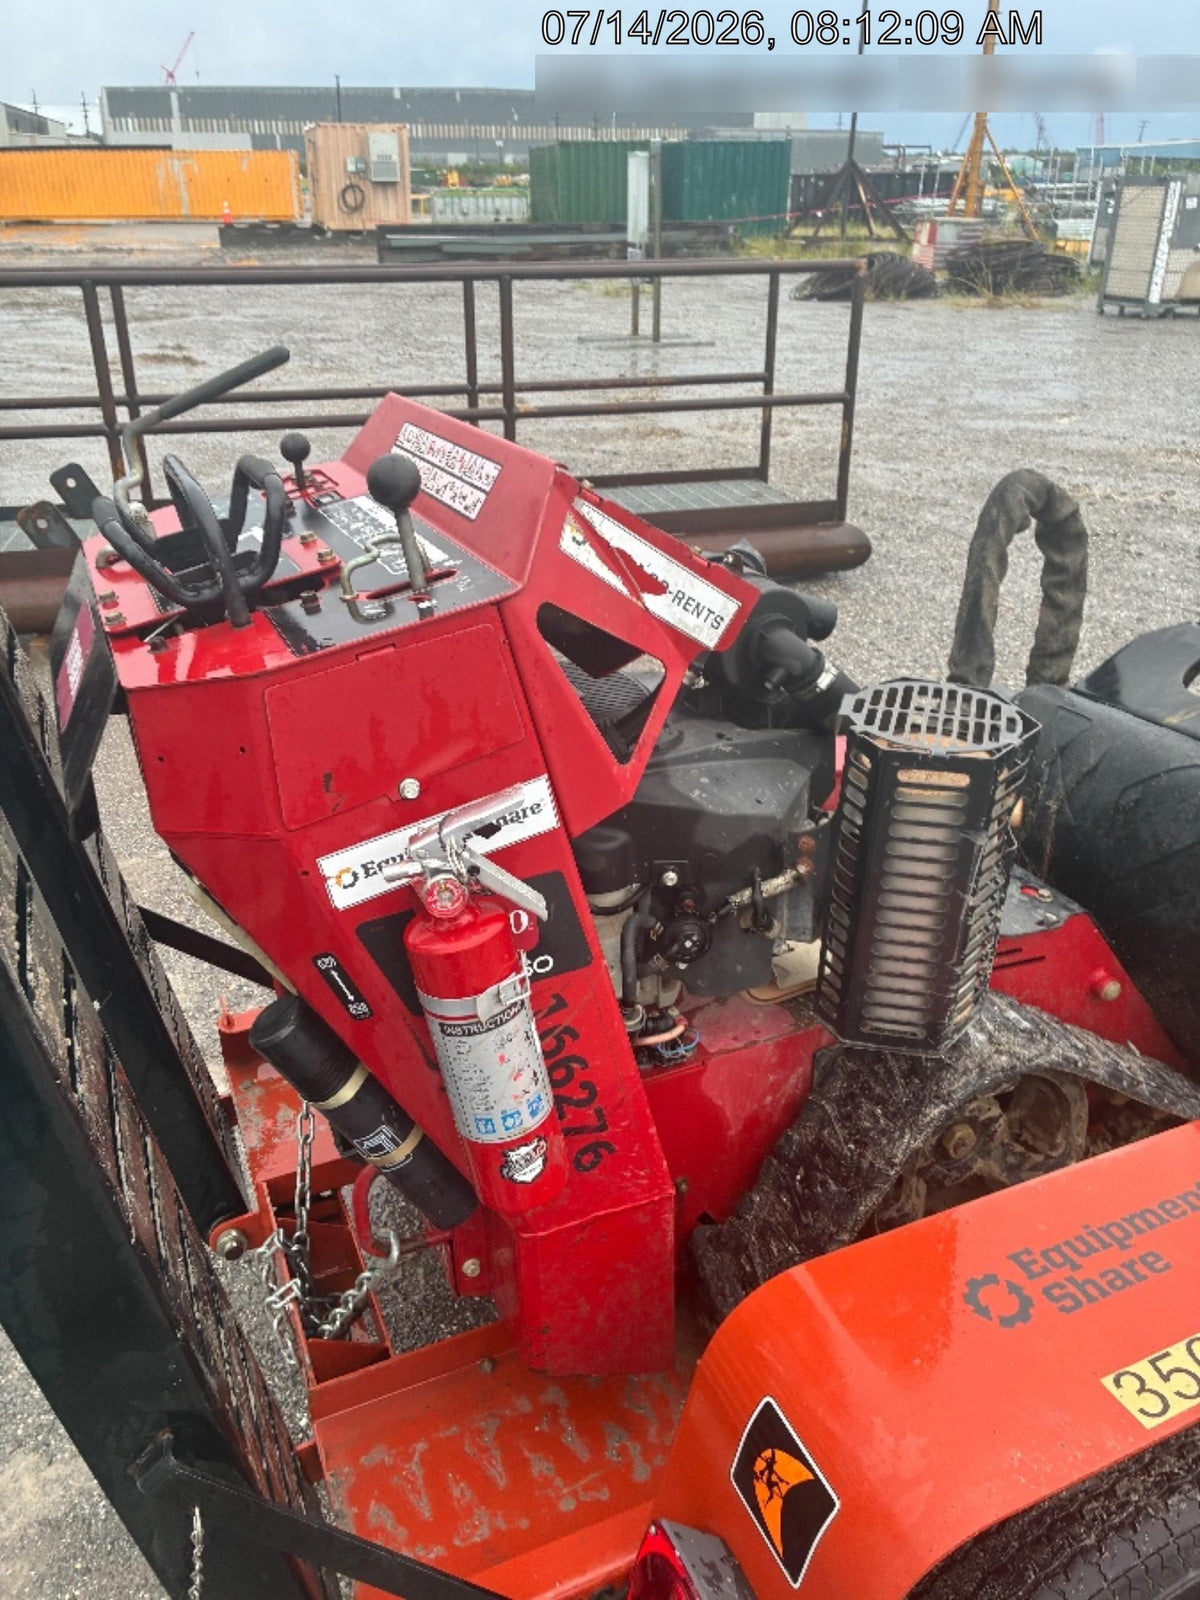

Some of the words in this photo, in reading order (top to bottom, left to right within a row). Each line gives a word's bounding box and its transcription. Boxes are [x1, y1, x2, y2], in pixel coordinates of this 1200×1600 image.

[533, 992, 617, 1173] 166276
[1006, 1180, 1200, 1281] Equipmen
[1041, 1250, 1174, 1315] Share
